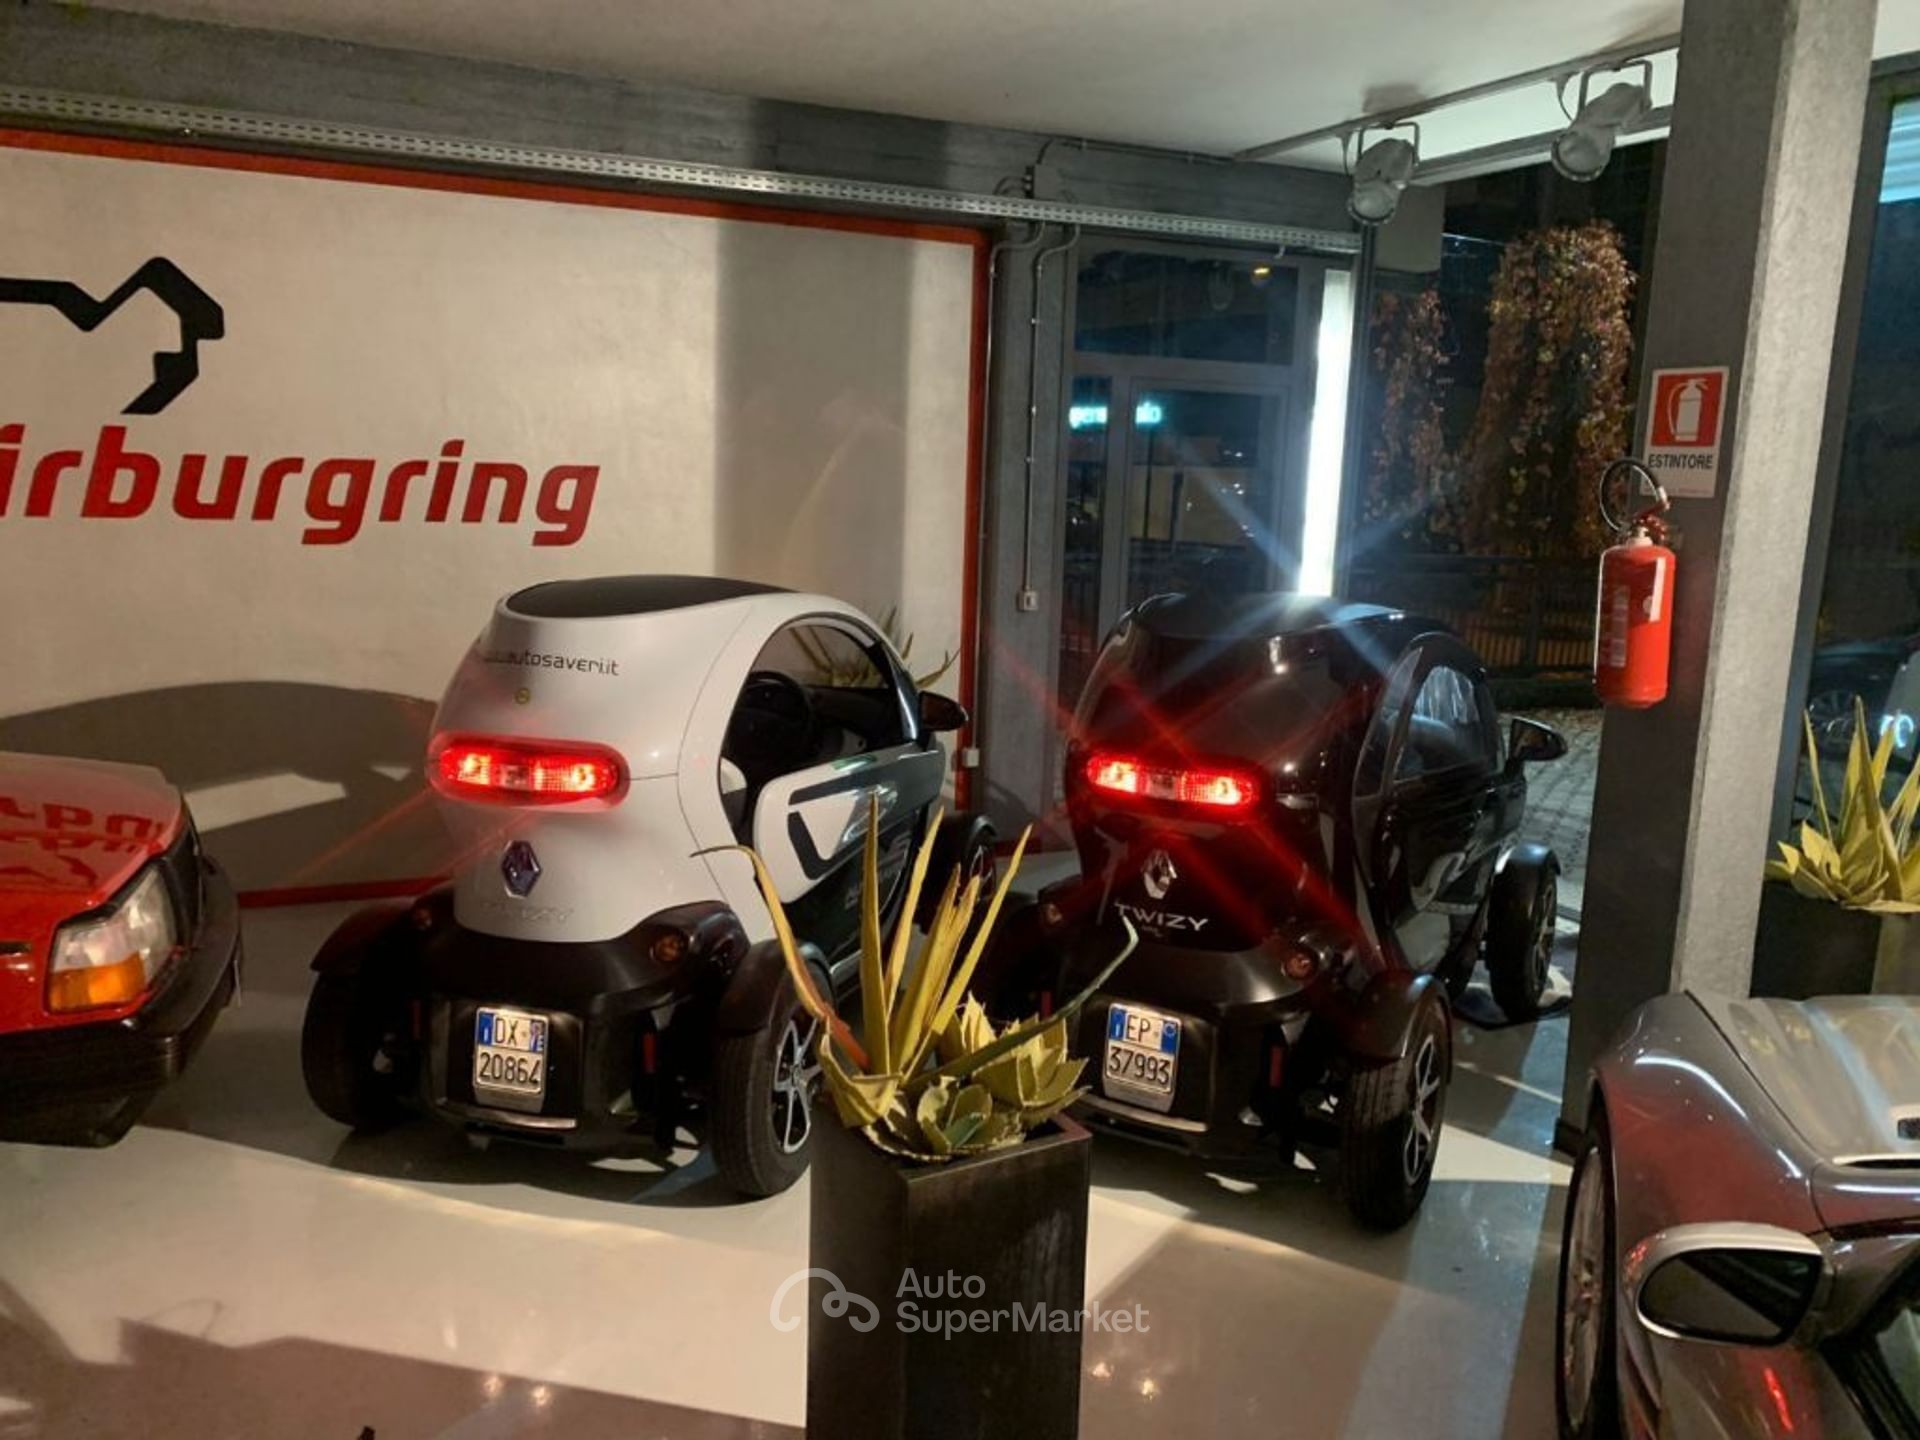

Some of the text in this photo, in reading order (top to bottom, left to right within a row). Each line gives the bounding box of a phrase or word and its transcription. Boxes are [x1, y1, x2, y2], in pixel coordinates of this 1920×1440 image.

[1648, 453, 1713, 469] ESTINTORE
[1114, 901, 1208, 931] TWIZY
[495, 1018, 519, 1046] DX
[1127, 1014, 1151, 1042] EP
[480, 1052, 541, 1084] 20864
[1110, 1046, 1170, 1085] 37993
